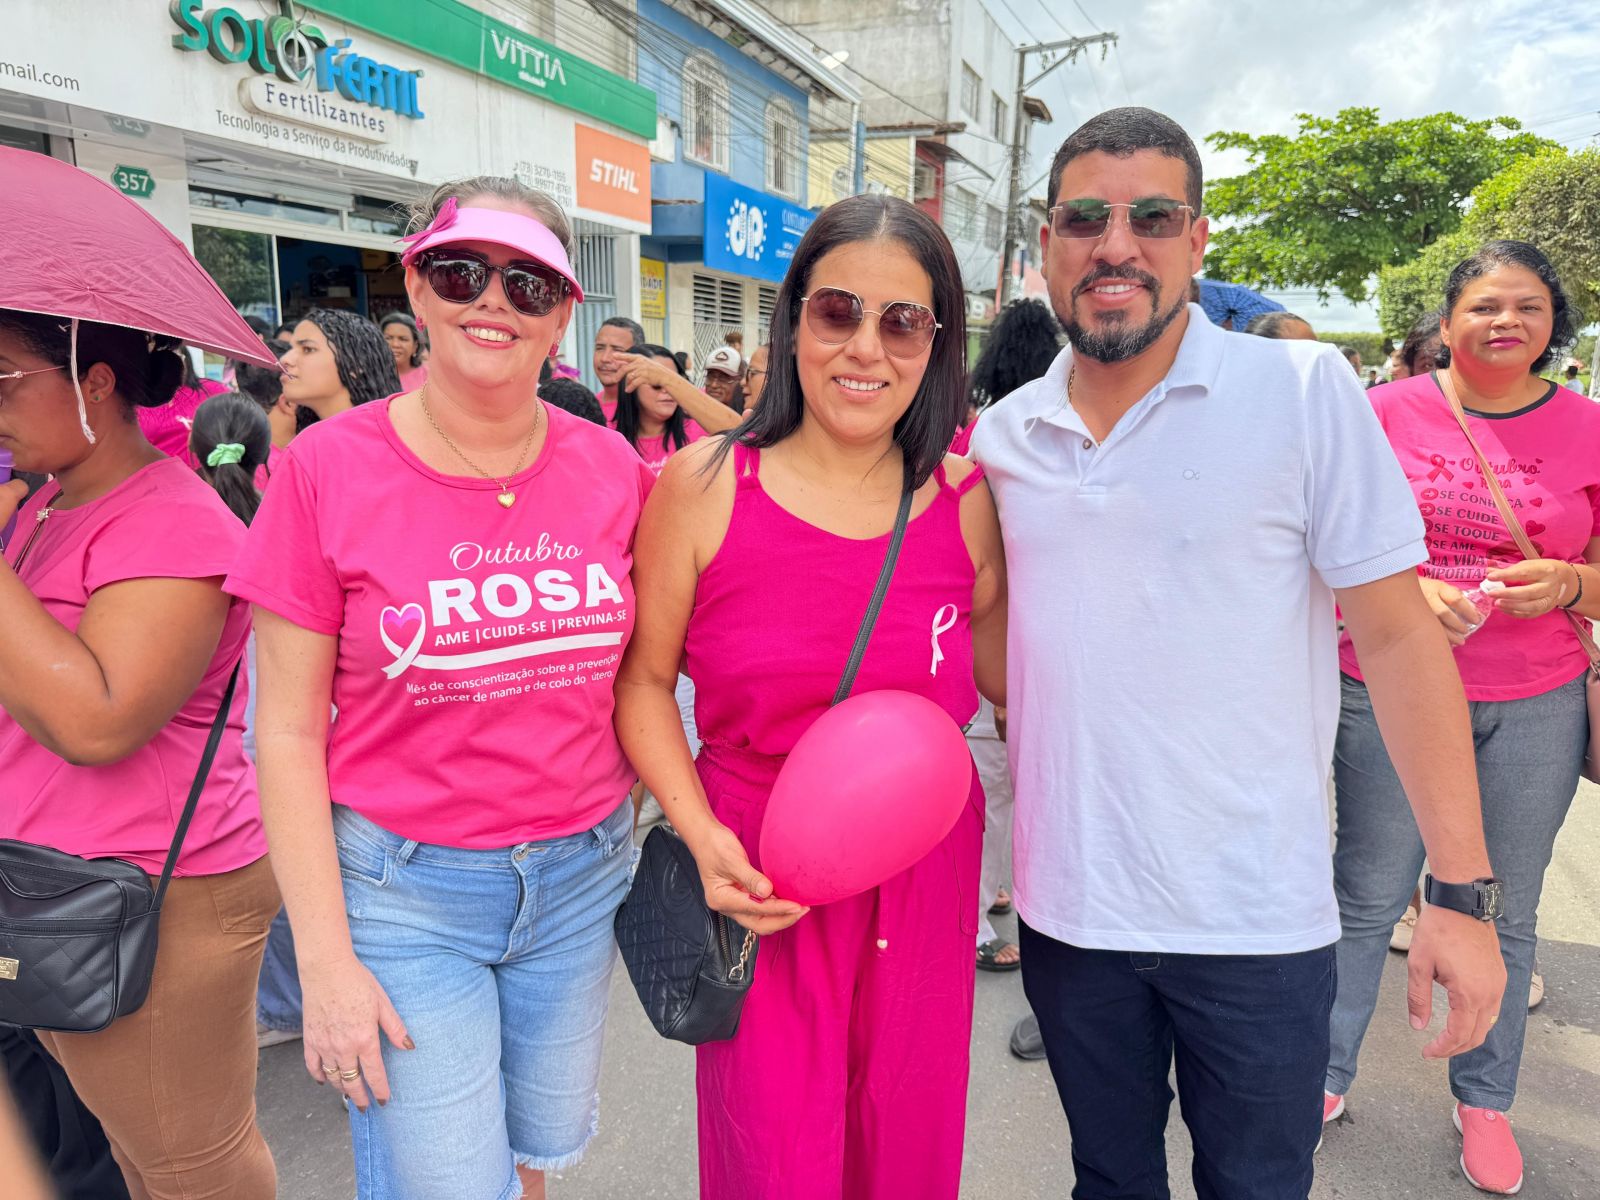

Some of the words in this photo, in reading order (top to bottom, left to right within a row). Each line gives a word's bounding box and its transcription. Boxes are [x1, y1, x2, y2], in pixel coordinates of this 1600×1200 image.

[491, 29, 566, 86] VITTIA
[265, 82, 385, 133] Fertilizantes
[216, 109, 279, 139] Tecnologia
[282, 127, 290, 140] a
[293, 128, 330, 154] Serviço
[333, 137, 346, 153] da
[118, 171, 149, 192] 357
[590, 158, 639, 194] STIHL
[1440, 490, 1455, 500] SE
[1436, 506, 1452, 516] SE
[1456, 508, 1499, 524] CUIDE
[1433, 540, 1447, 549] SE
[1450, 541, 1476, 550] AME
[1434, 523, 1449, 534] SE
[1454, 525, 1500, 541] TOQUE
[450, 532, 583, 571] Outubro
[1454, 554, 1486, 566] VIDA
[428, 563, 624, 627] ROSA
[434, 630, 470, 647] AME
[406, 682, 427, 695] Mês
[430, 681, 444, 691] de
[447, 668, 535, 690] conscientização
[537, 663, 566, 676] sobre
[576, 652, 619, 672] prevenção
[414, 697, 429, 706] ao
[432, 693, 471, 704] câncer
[473, 692, 487, 703] de
[489, 687, 522, 700] mama
[533, 681, 546, 691] de
[549, 677, 572, 689] colo
[574, 675, 586, 685] do
